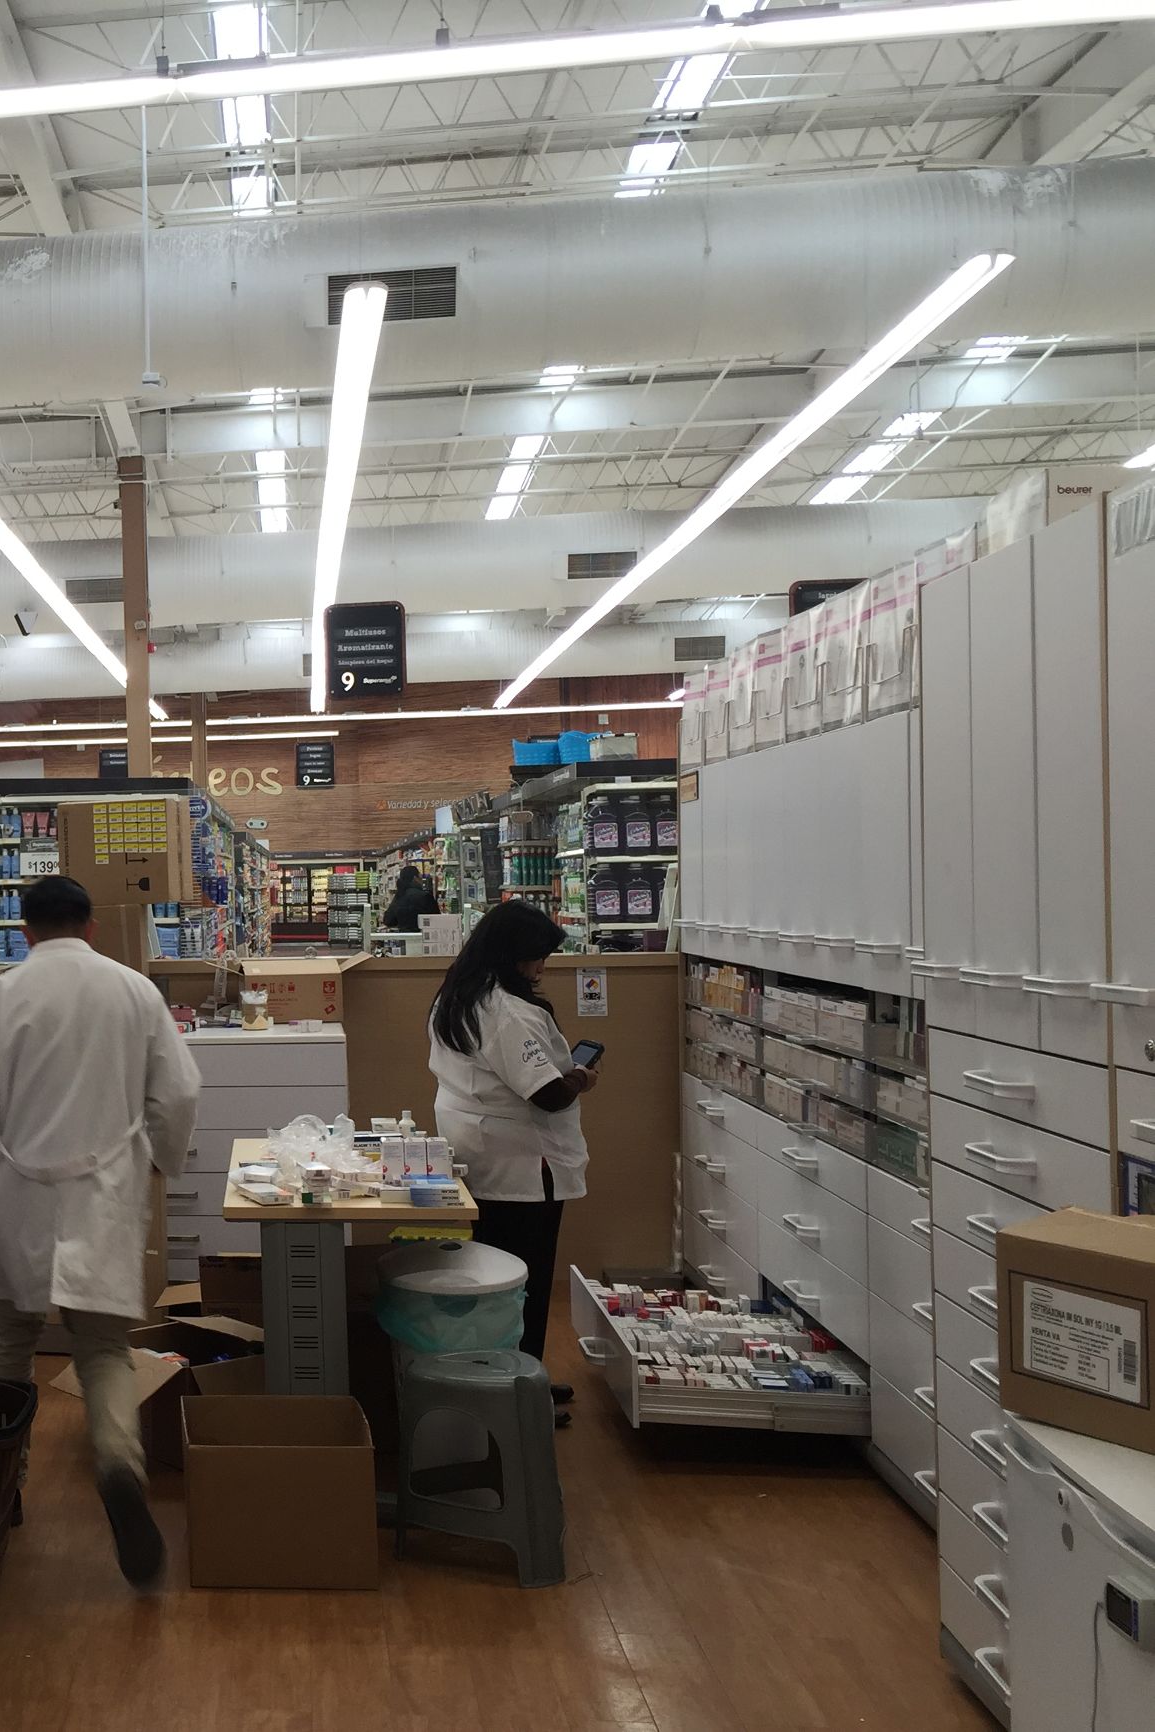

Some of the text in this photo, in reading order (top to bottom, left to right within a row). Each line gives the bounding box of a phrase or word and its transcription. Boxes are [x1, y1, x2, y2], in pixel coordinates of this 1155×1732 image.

[1057, 485, 1093, 494] beurer
[344, 629, 387, 637] Multiusos
[341, 672, 355, 691] 9
[303, 775, 310, 785] 9
[387, 799, 422, 810] Variedad
[423, 800, 429, 810] y
[1031, 1326, 1051, 1338] VENTA
[1052, 1332, 1061, 1342] VA
